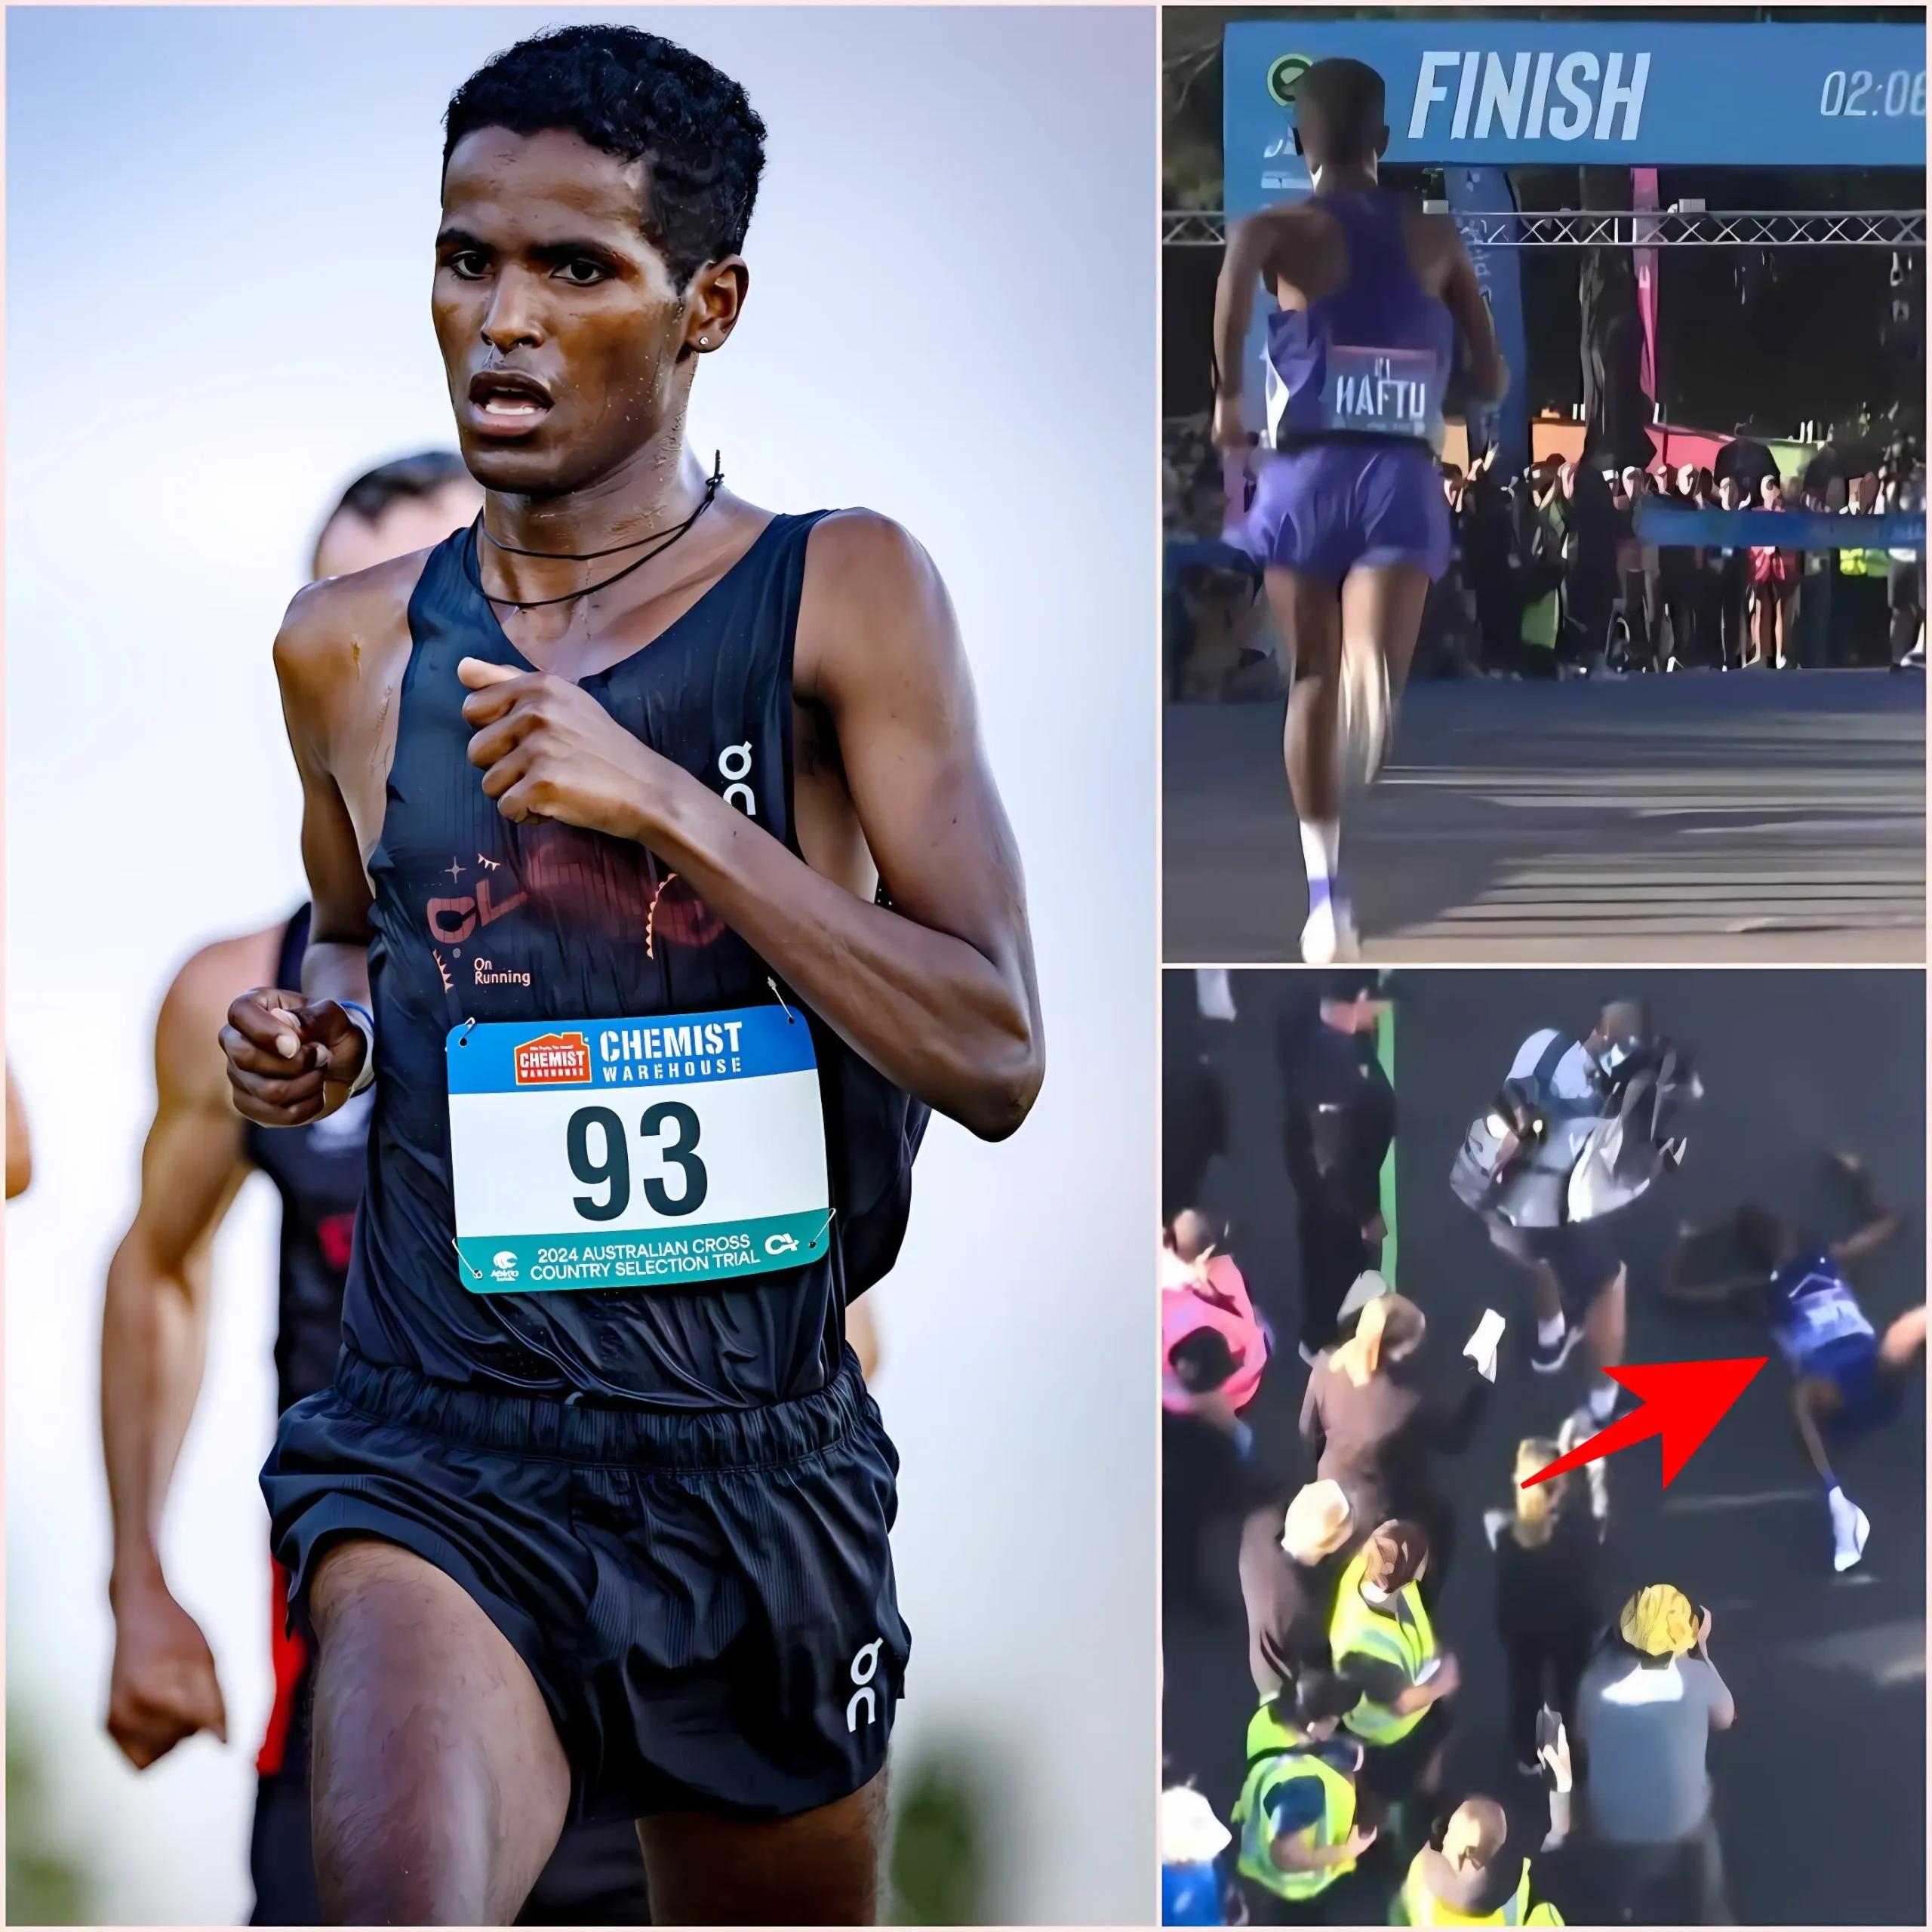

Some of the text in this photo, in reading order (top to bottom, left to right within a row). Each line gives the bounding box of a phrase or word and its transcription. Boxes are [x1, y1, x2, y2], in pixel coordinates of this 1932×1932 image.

[1408, 51, 1651, 141] FINISH
[474, 957, 493, 971] On
[475, 969, 531, 987] Running
[600, 1021, 743, 1063] CHEMIST
[519, 1051, 586, 1068] CHEMIST
[602, 1057, 742, 1083] WAREHOUSE
[566, 1100, 708, 1222] 93
[537, 1248, 579, 1263] 2024
[583, 1240, 689, 1261] AUSTRALIAN
[692, 1233, 751, 1253] CROSS
[530, 1262, 610, 1281] COUNTRY
[615, 1256, 709, 1277] SELECTION
[712, 1249, 761, 1268] TRIAL
